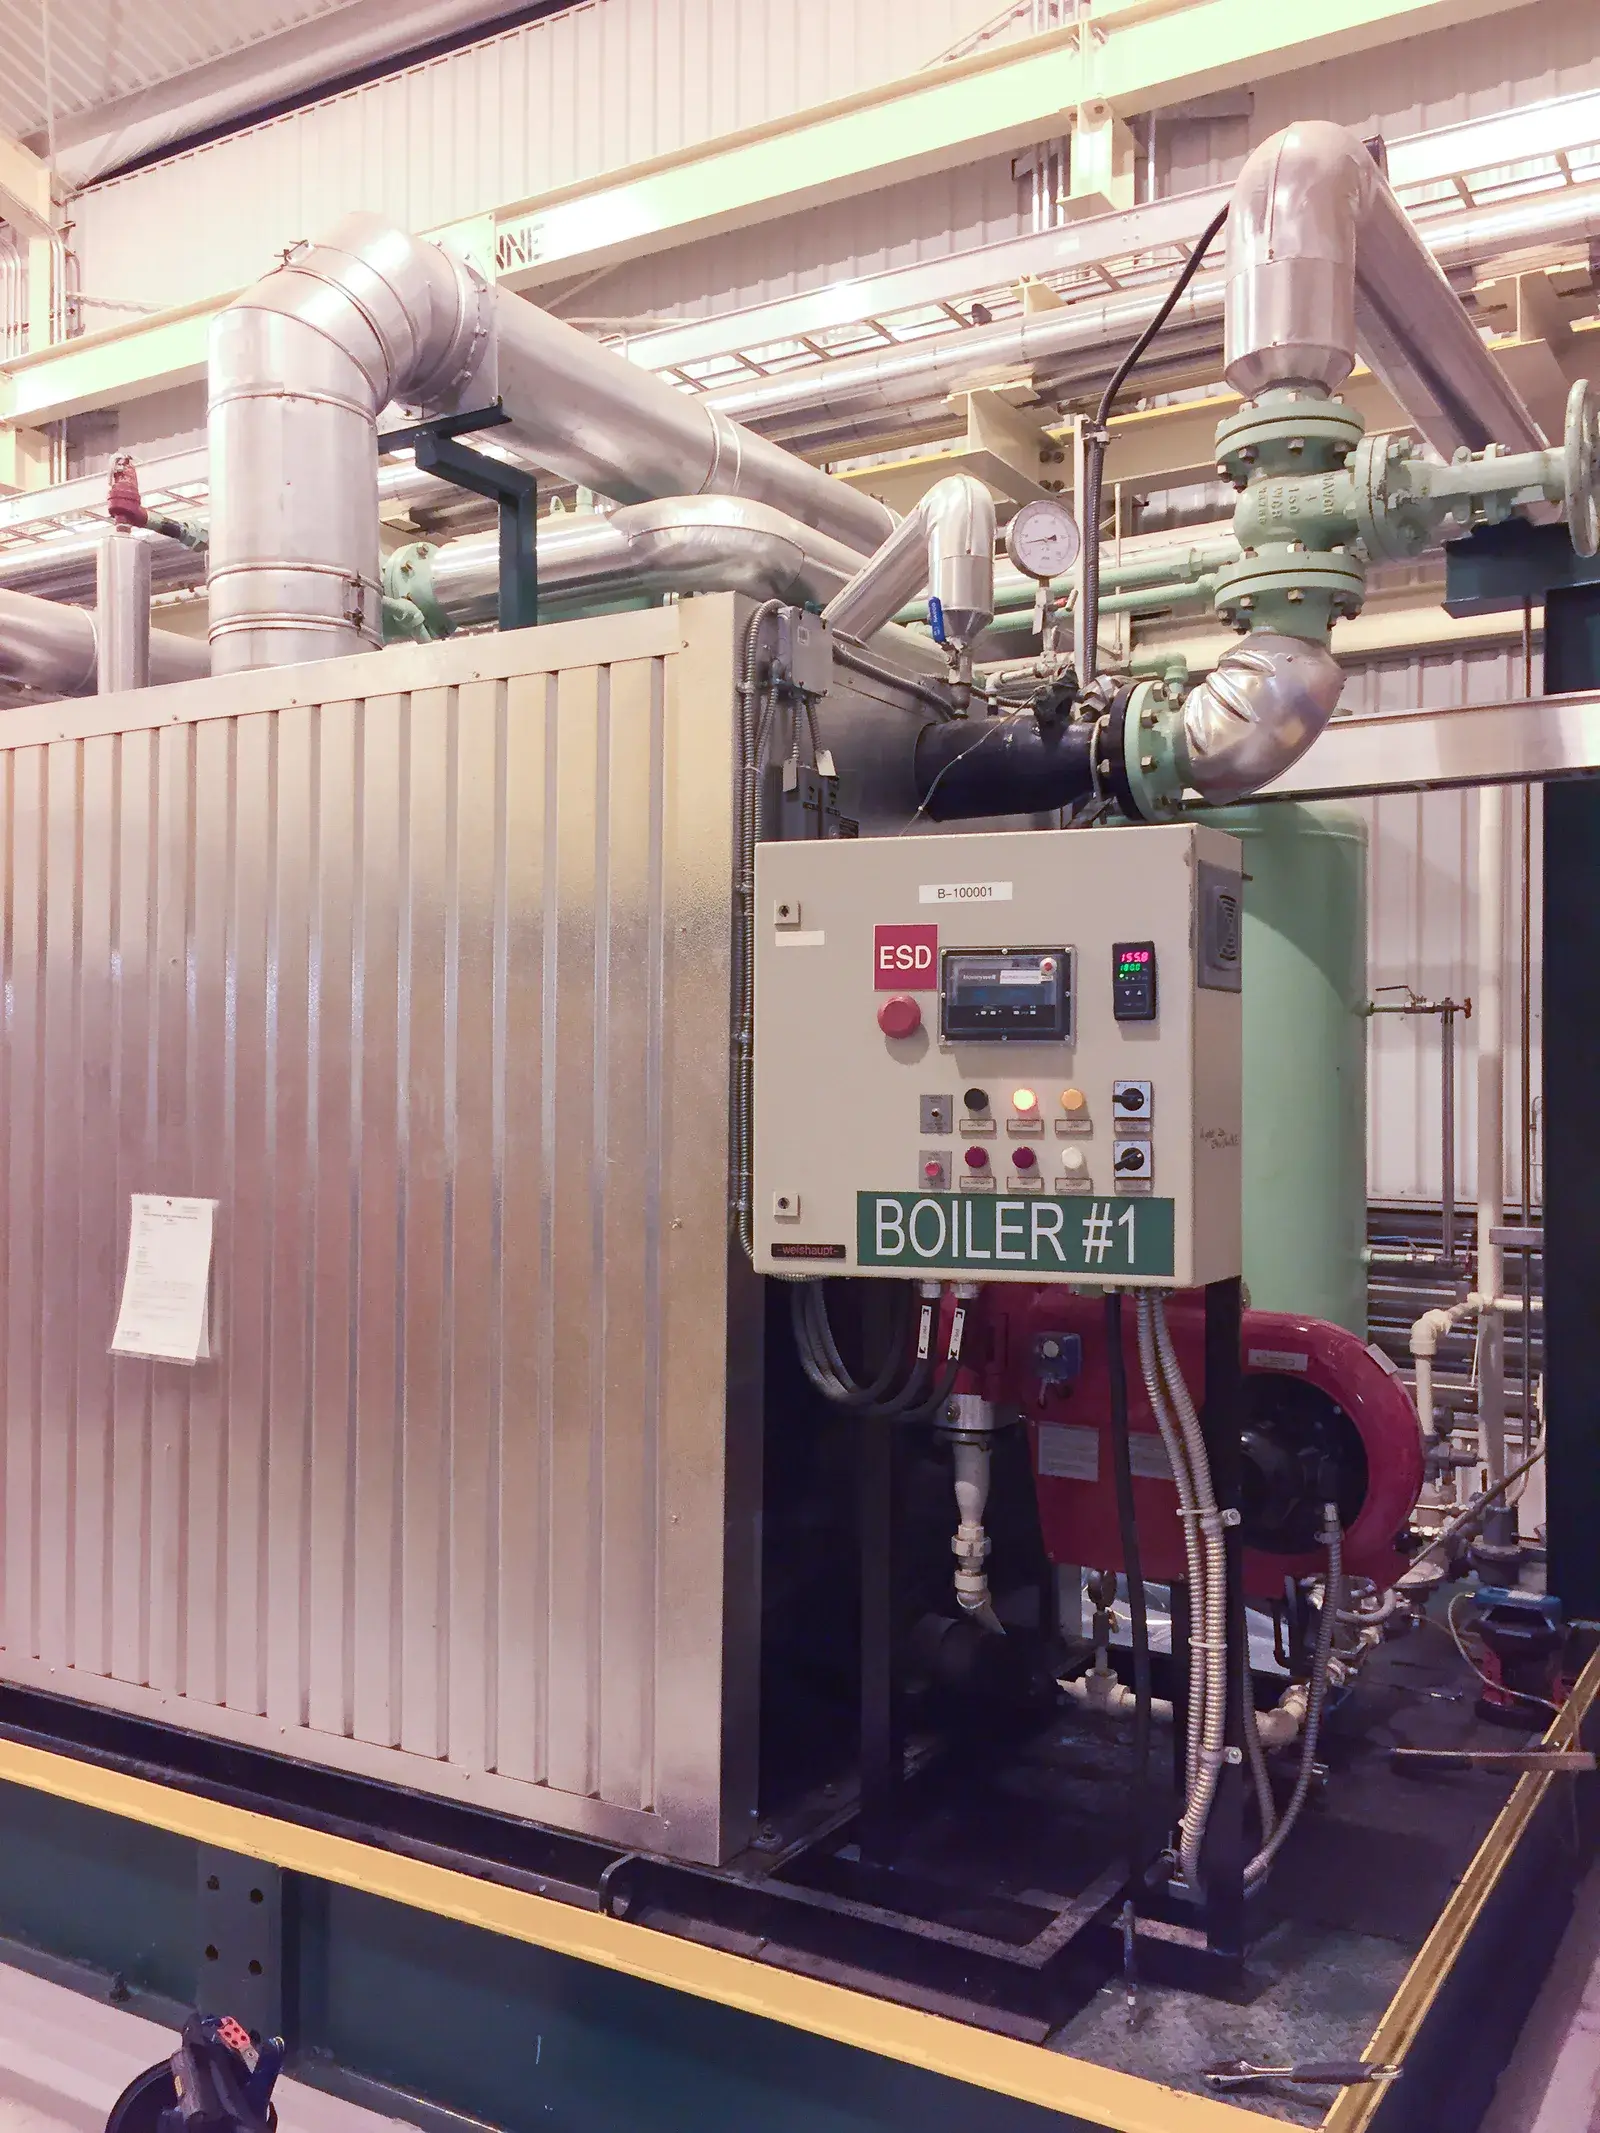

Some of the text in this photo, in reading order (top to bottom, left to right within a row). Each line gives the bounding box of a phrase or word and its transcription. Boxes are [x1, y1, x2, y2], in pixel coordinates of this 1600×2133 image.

[937, 886, 993, 899] B-100001
[879, 944, 932, 970] ESD
[875, 1198, 1136, 1264] BOILER #1
